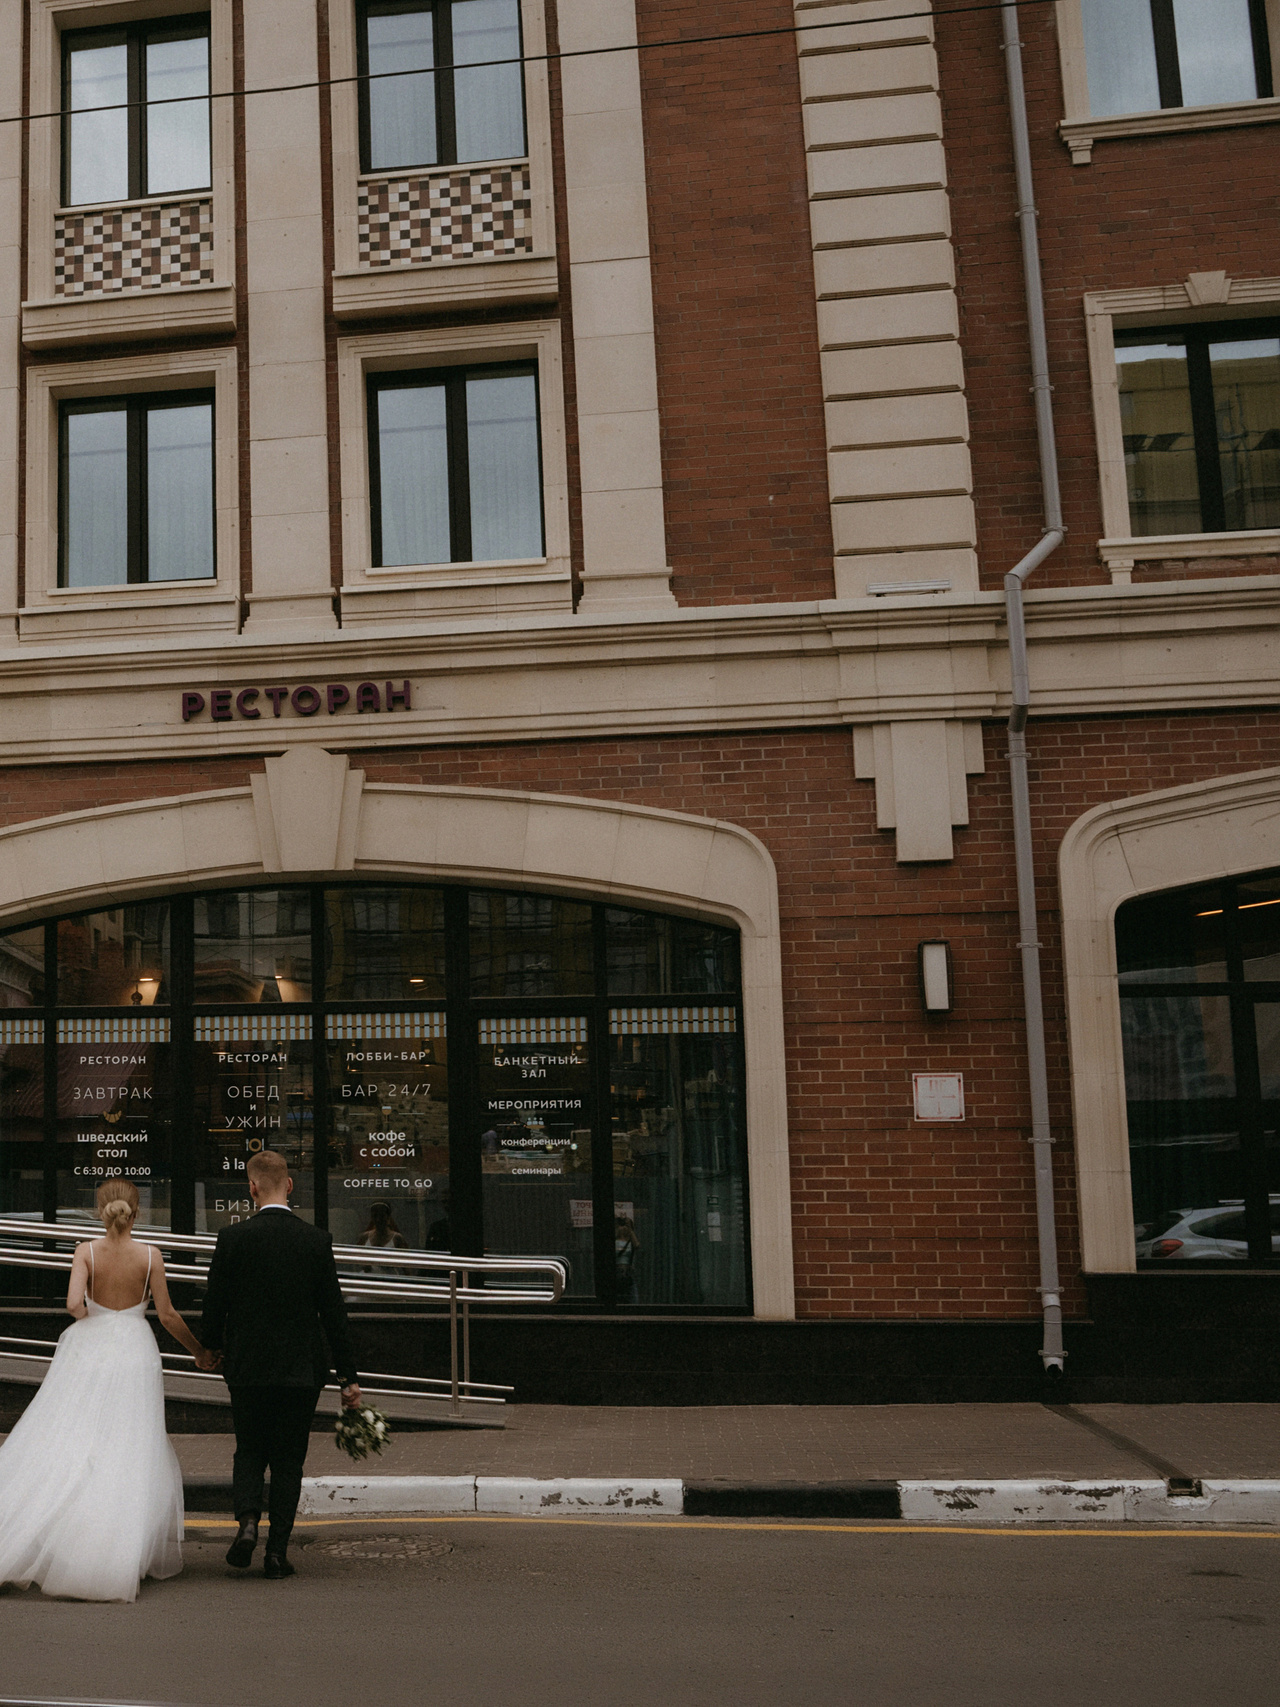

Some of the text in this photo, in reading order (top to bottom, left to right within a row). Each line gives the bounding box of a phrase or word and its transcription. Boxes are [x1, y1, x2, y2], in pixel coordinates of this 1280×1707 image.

[182, 680, 411, 721] РЕСТОРАН
[79, 1055, 147, 1065] РЕСТОРАН
[218, 1053, 288, 1063] РЕСТОРАН
[346, 1051, 426, 1061] ЛОББИ-БАР
[493, 1053, 579, 1066] БАНКЕТНЫЙ
[521, 1068, 547, 1079] ЗАЛ
[73, 1086, 153, 1100] ЗАВТРАК
[227, 1085, 280, 1101] ОБЕД
[341, 1083, 431, 1097] БАР 24/7
[488, 1099, 582, 1110] МЕРОПРИЯТИЯ
[224, 1115, 281, 1128] УЖИН
[77, 1129, 148, 1144] шведский
[368, 1130, 406, 1143] кофе
[501, 1137, 571, 1148] конференции
[96, 1149, 128, 1158] стол
[359, 1143, 416, 1157] с собой
[222, 1156, 246, 1170] à la
[73, 1167, 151, 1177] С 6:30 ДО 10:00
[511, 1167, 562, 1177] семинары
[343, 1178, 433, 1188] COFFEE TO GO
[215, 1199, 300, 1212] БИЗ-
